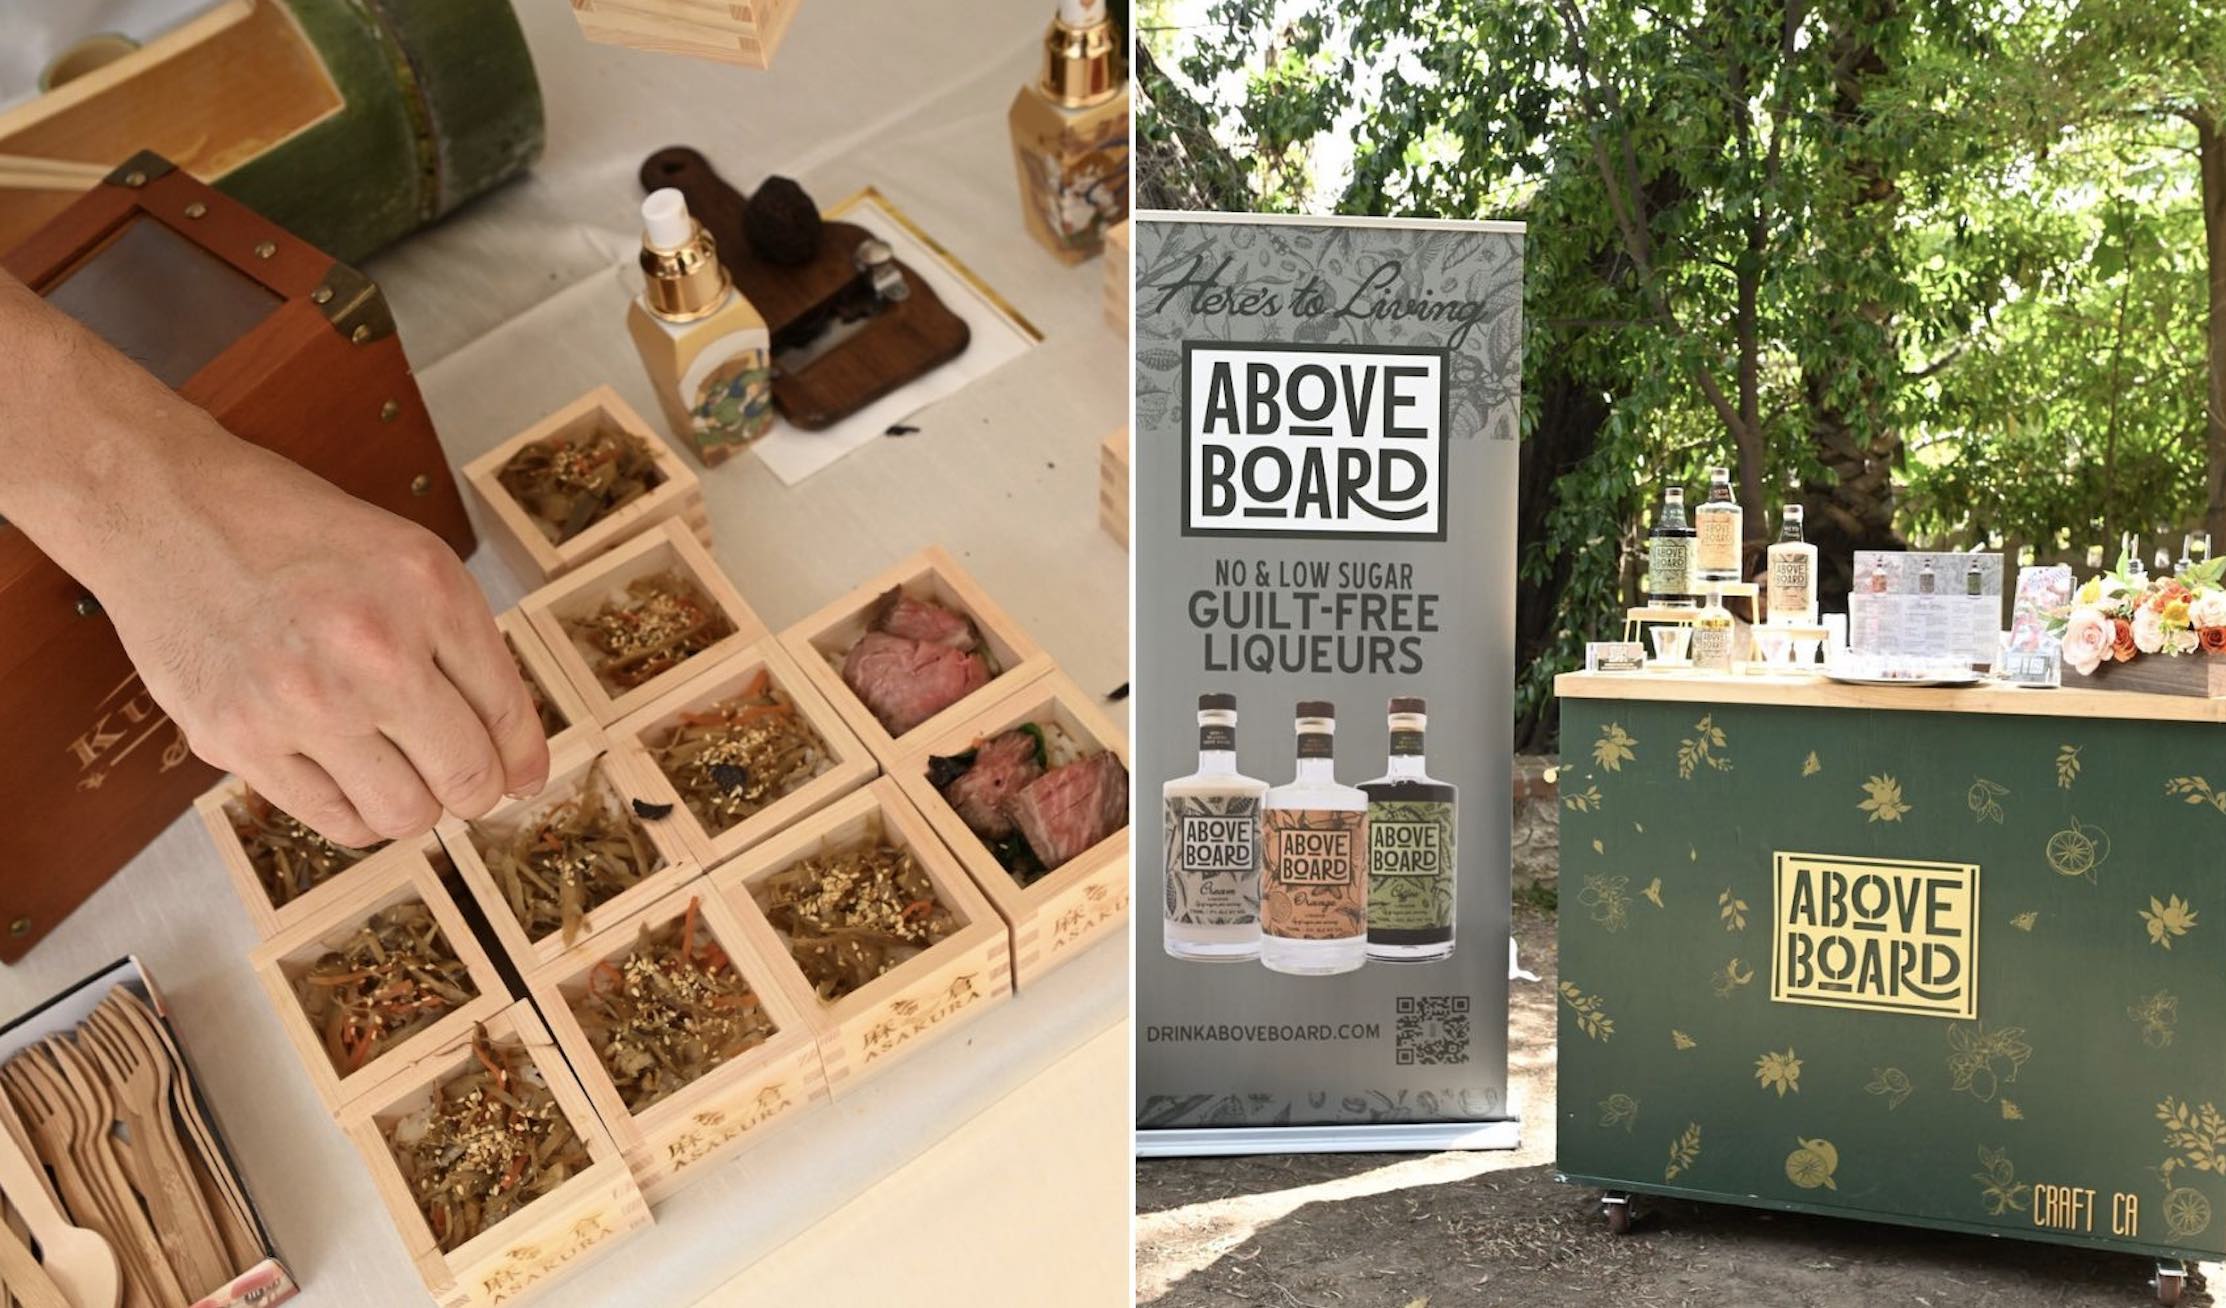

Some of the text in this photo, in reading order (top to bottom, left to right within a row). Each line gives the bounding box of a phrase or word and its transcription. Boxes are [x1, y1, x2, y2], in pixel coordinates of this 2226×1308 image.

[1153, 254, 1491, 350] Here's to Living
[1202, 361, 1429, 439] ABOVE
[1201, 444, 1429, 521] BOARD
[1215, 559, 1413, 590] NO & LOW SUGAR
[1188, 590, 1439, 632] GUILT-FREE
[1204, 633, 1424, 675] LIQUEURS
[1186, 821, 1250, 843] ABOVE
[1283, 833, 1348, 857] ABOVE
[1373, 826, 1438, 848] ABOVE
[1186, 844, 1250, 867] BOARD
[1283, 857, 1347, 880] BOARD
[1373, 849, 1437, 872] BOARD
[1789, 868, 1963, 938] ABOVE
[1788, 931, 1961, 1001] BOARD
[864, 990, 980, 1064] ASAKURA
[1147, 1023, 1380, 1042] DRINKABOVEBOARD.COM
[673, 1099, 792, 1172] ASAKURA
[2034, 1183, 2138, 1238] CRAFT CA
[494, 1228, 613, 1306] ASAKURA
